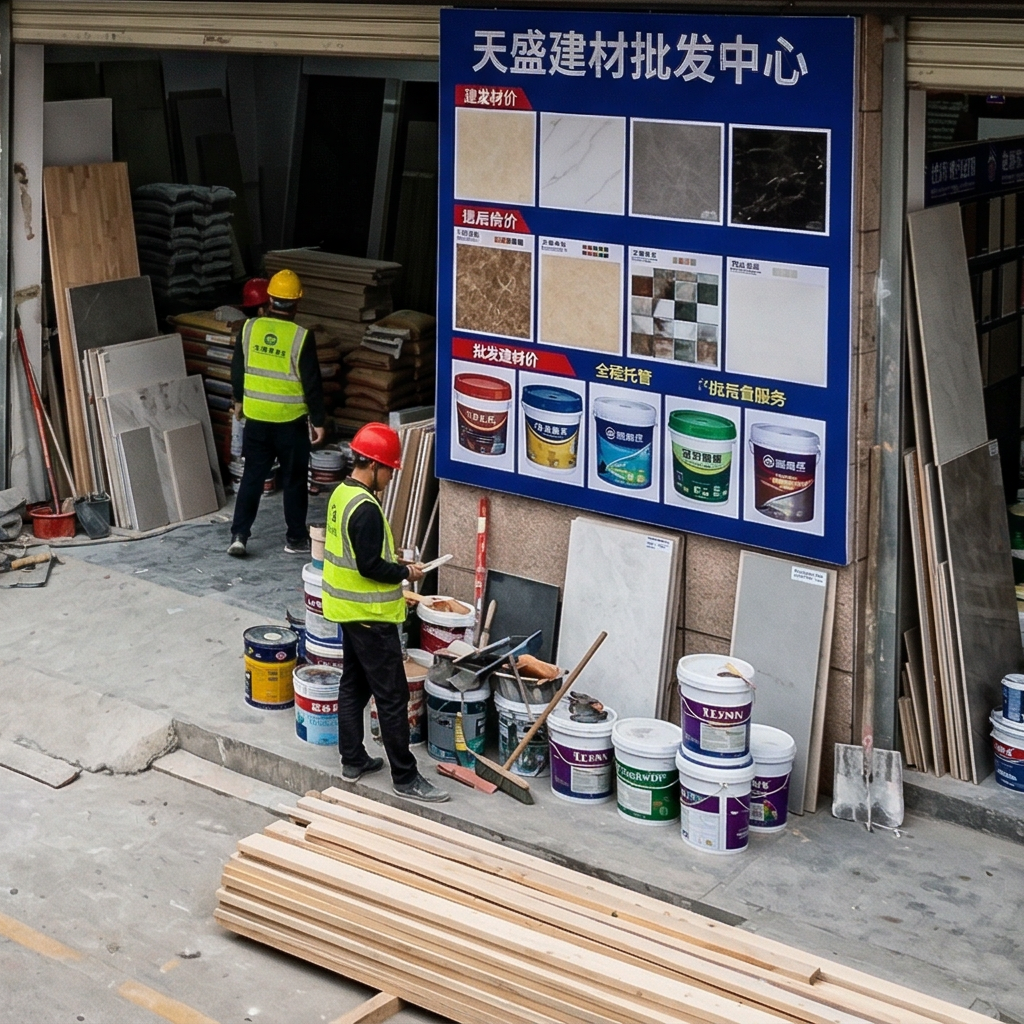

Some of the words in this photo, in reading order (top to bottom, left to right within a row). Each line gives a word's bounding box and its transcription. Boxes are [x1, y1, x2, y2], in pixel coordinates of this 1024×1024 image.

[471, 29, 809, 87] 天盛建材批发中心
